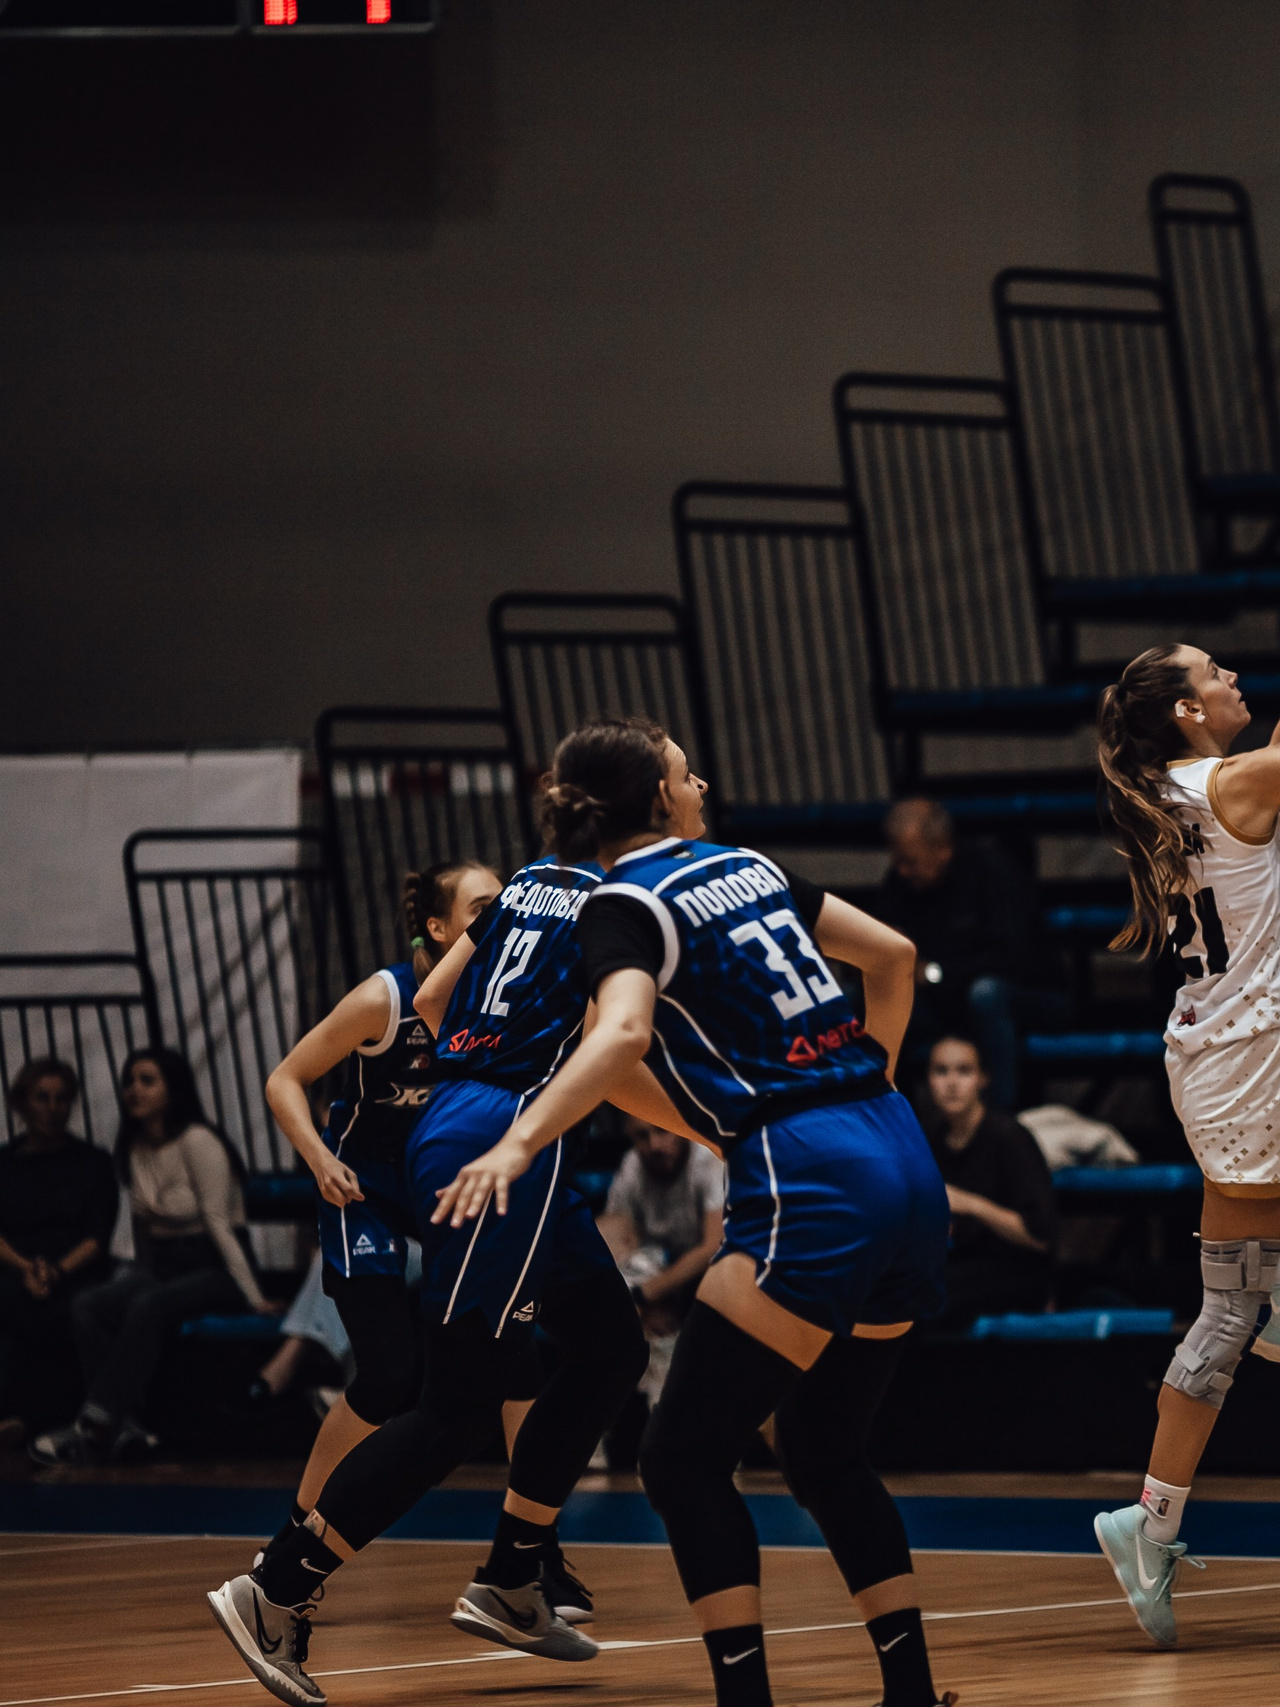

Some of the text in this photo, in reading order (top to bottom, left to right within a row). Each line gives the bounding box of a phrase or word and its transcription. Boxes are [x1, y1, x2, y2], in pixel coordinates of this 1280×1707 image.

[500, 880, 590, 922] ФЕДОТОВА
[673, 863, 786, 928] ПОПОВА
[480, 927, 543, 1017] 12
[727, 908, 844, 1021] 33
